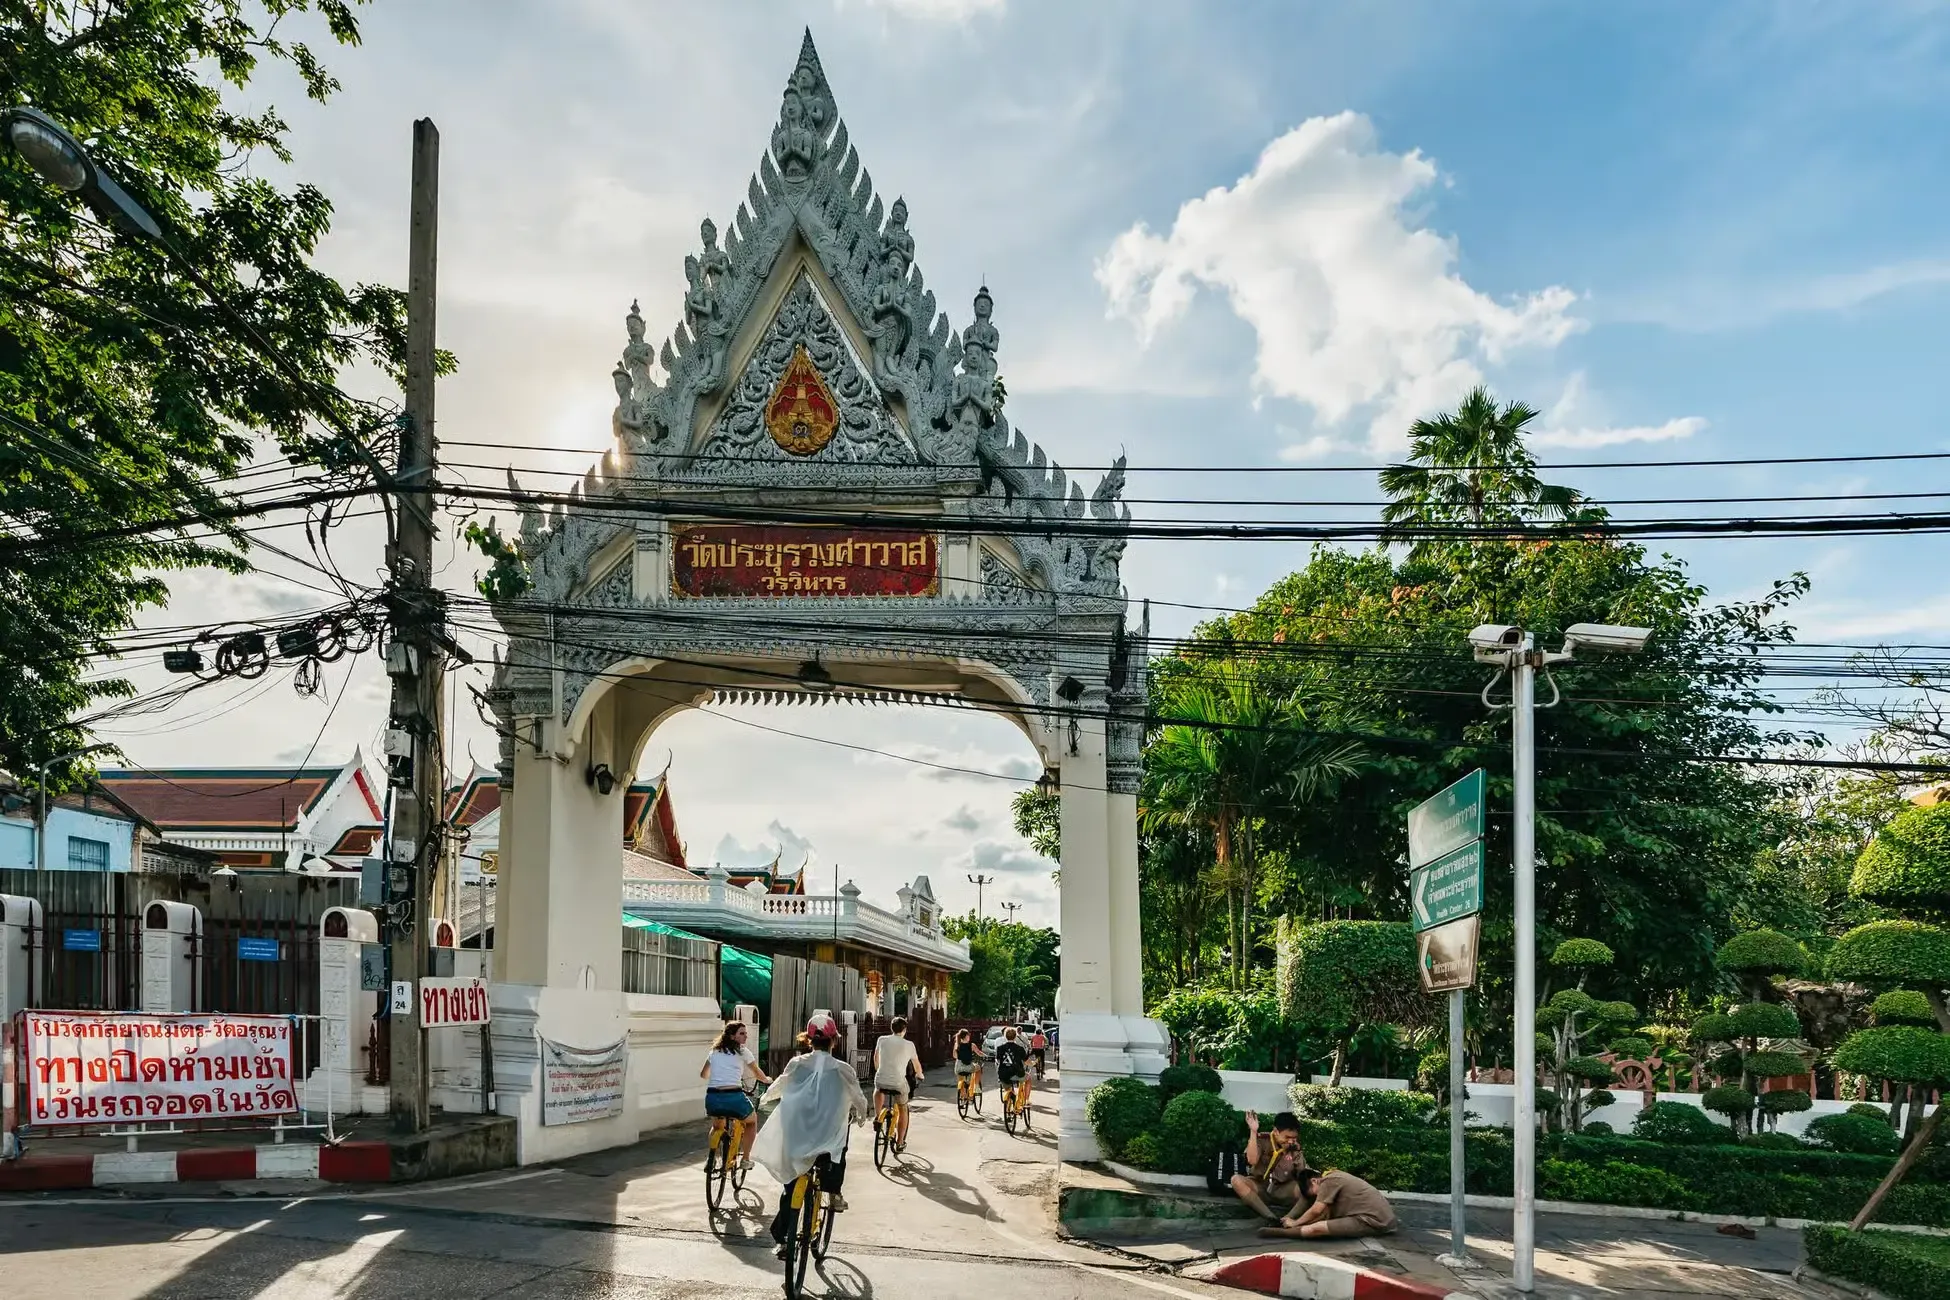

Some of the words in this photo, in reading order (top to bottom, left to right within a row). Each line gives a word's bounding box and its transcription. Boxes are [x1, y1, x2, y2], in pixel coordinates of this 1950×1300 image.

[682, 534, 927, 576] วัดประยุรวงศาวาส
[761, 572, 846, 591] วรวิหาร
[395, 1000, 406, 1010] 24
[423, 979, 487, 1024] ทางเข้า
[35, 1046, 286, 1083] ทางปิดห้ามเข้า
[36, 1083, 293, 1119] เว้นรถจอดในวัด
